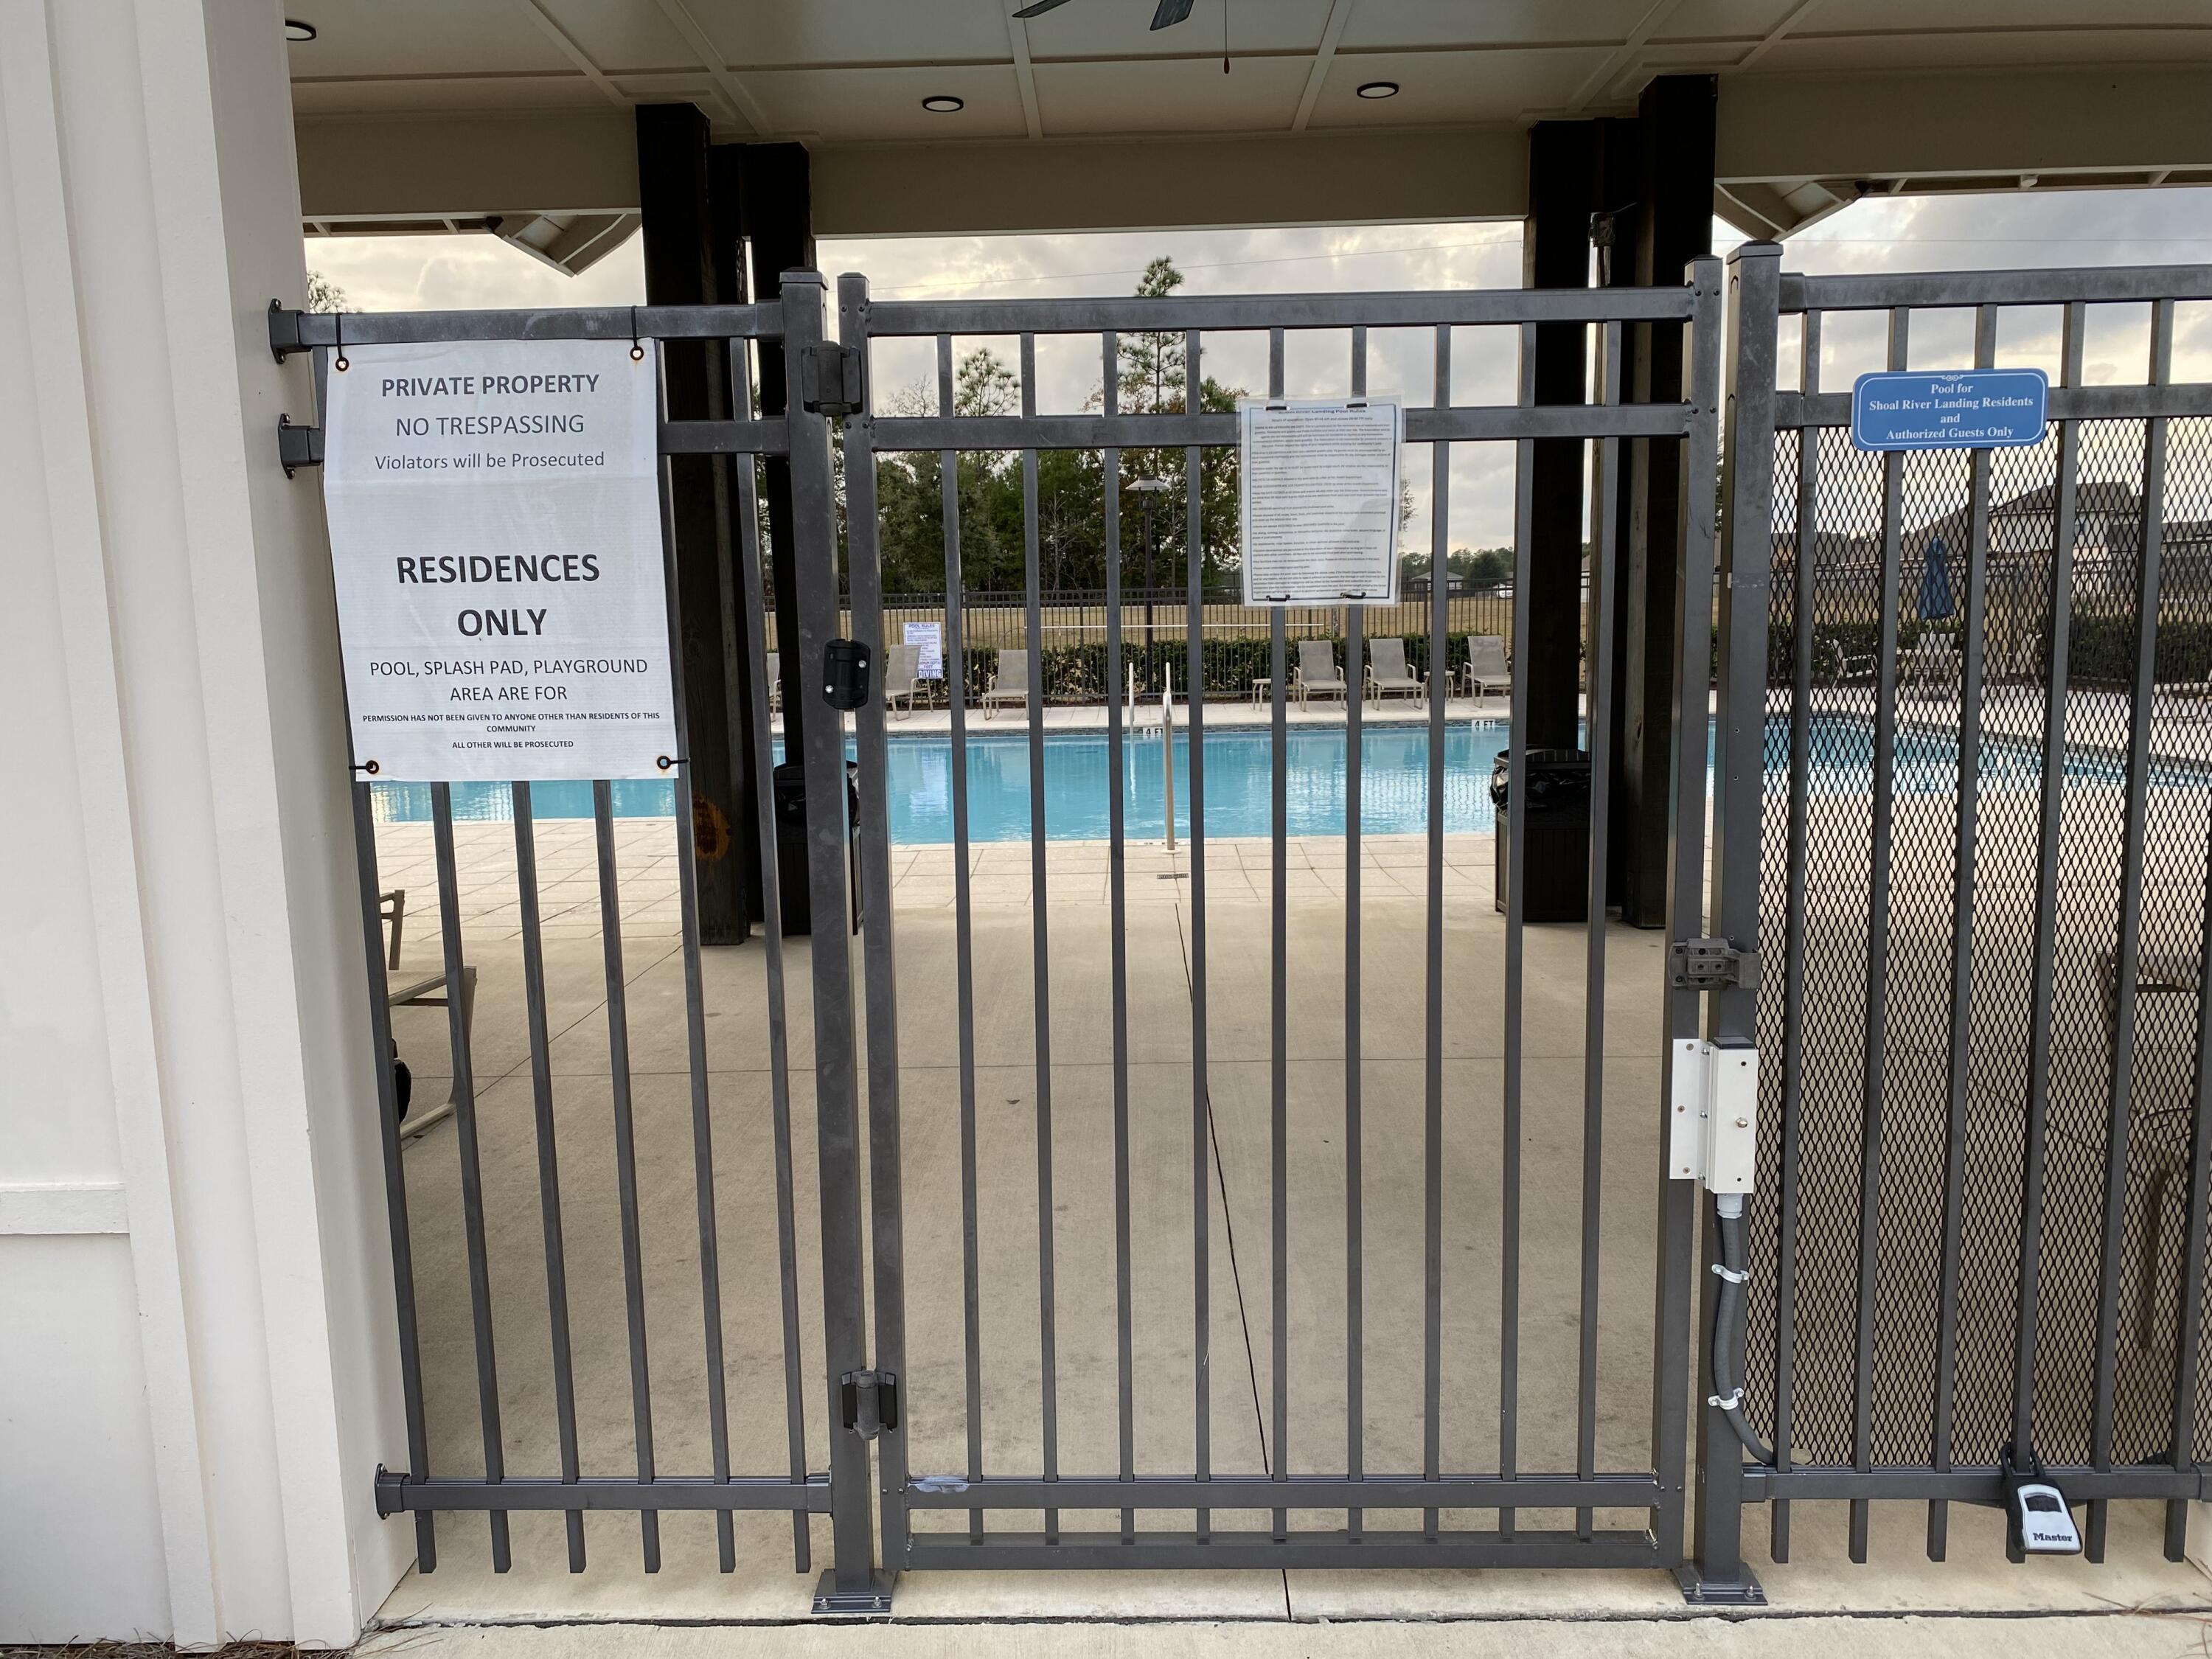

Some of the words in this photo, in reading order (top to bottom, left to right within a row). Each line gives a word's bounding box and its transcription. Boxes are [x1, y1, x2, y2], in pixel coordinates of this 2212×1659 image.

[383, 377, 474, 397] PRIVATE
[483, 375, 599, 394] PROPERTY
[1931, 383, 1954, 394] Pool
[1958, 383, 1973, 393] for
[1870, 400, 1899, 411] Shoal
[1902, 400, 1932, 409] River
[1935, 398, 1979, 408] Landing
[1983, 397, 2033, 407] Residents
[1941, 413, 1960, 422] and
[397, 418, 428, 436] NO
[436, 414, 583, 435] TRESPASSING
[1886, 428, 1945, 439] Authorized
[1949, 428, 1984, 438] Guests
[1987, 426, 2013, 438] Only
[375, 455, 448, 469] Violators
[453, 453, 480, 467] will
[487, 453, 506, 467] be
[512, 451, 604, 467] Prosecuted
[397, 554, 599, 583] RESIDENCES
[458, 609, 546, 636] ONLY
[370, 662, 419, 678] POOL,
[425, 661, 484, 675] SPLASH
[490, 661, 528, 676] PAD,
[534, 659, 647, 674] PLAYGROUND
[919, 669, 941, 678] DIVING
[451, 687, 493, 700] AREA
[498, 687, 529, 700] ARE
[535, 686, 567, 700] FOR
[363, 714, 408, 723] PERMISSION
[411, 714, 425, 722] HAS
[428, 714, 444, 722] NOT
[446, 714, 465, 722] BEEN
[467, 713, 490, 721] GIVEN
[492, 713, 502, 721] TO
[504, 713, 536, 721] ANYONE
[538, 712, 563, 720] OTHER
[566, 712, 587, 720] THAN
[589, 712, 629, 720] RESIDENTS
[631, 712, 641, 720] OF
[643, 712, 660, 720] THIS
[2033, 1533, 2073, 1542] Master
